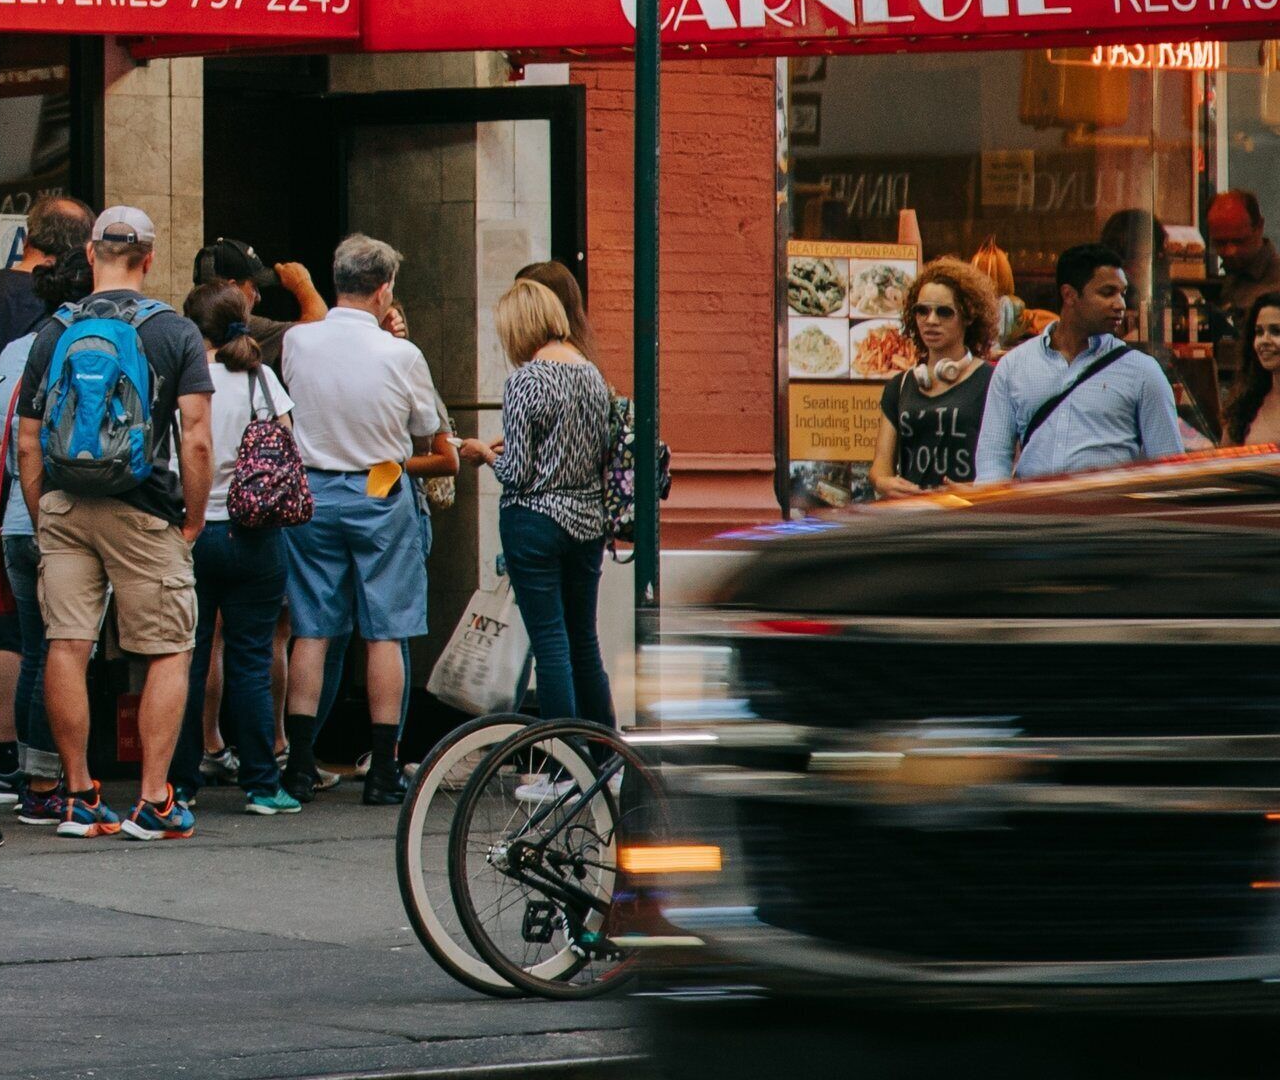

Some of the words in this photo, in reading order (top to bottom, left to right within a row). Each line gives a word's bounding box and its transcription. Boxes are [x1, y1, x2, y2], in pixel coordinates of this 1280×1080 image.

[824, 245, 852, 256] YOUR
[854, 245, 881, 256] OWN
[883, 245, 915, 257] PASTA
[803, 396, 848, 412] Seating
[795, 415, 850, 432] Including
[811, 433, 851, 450] Dining
